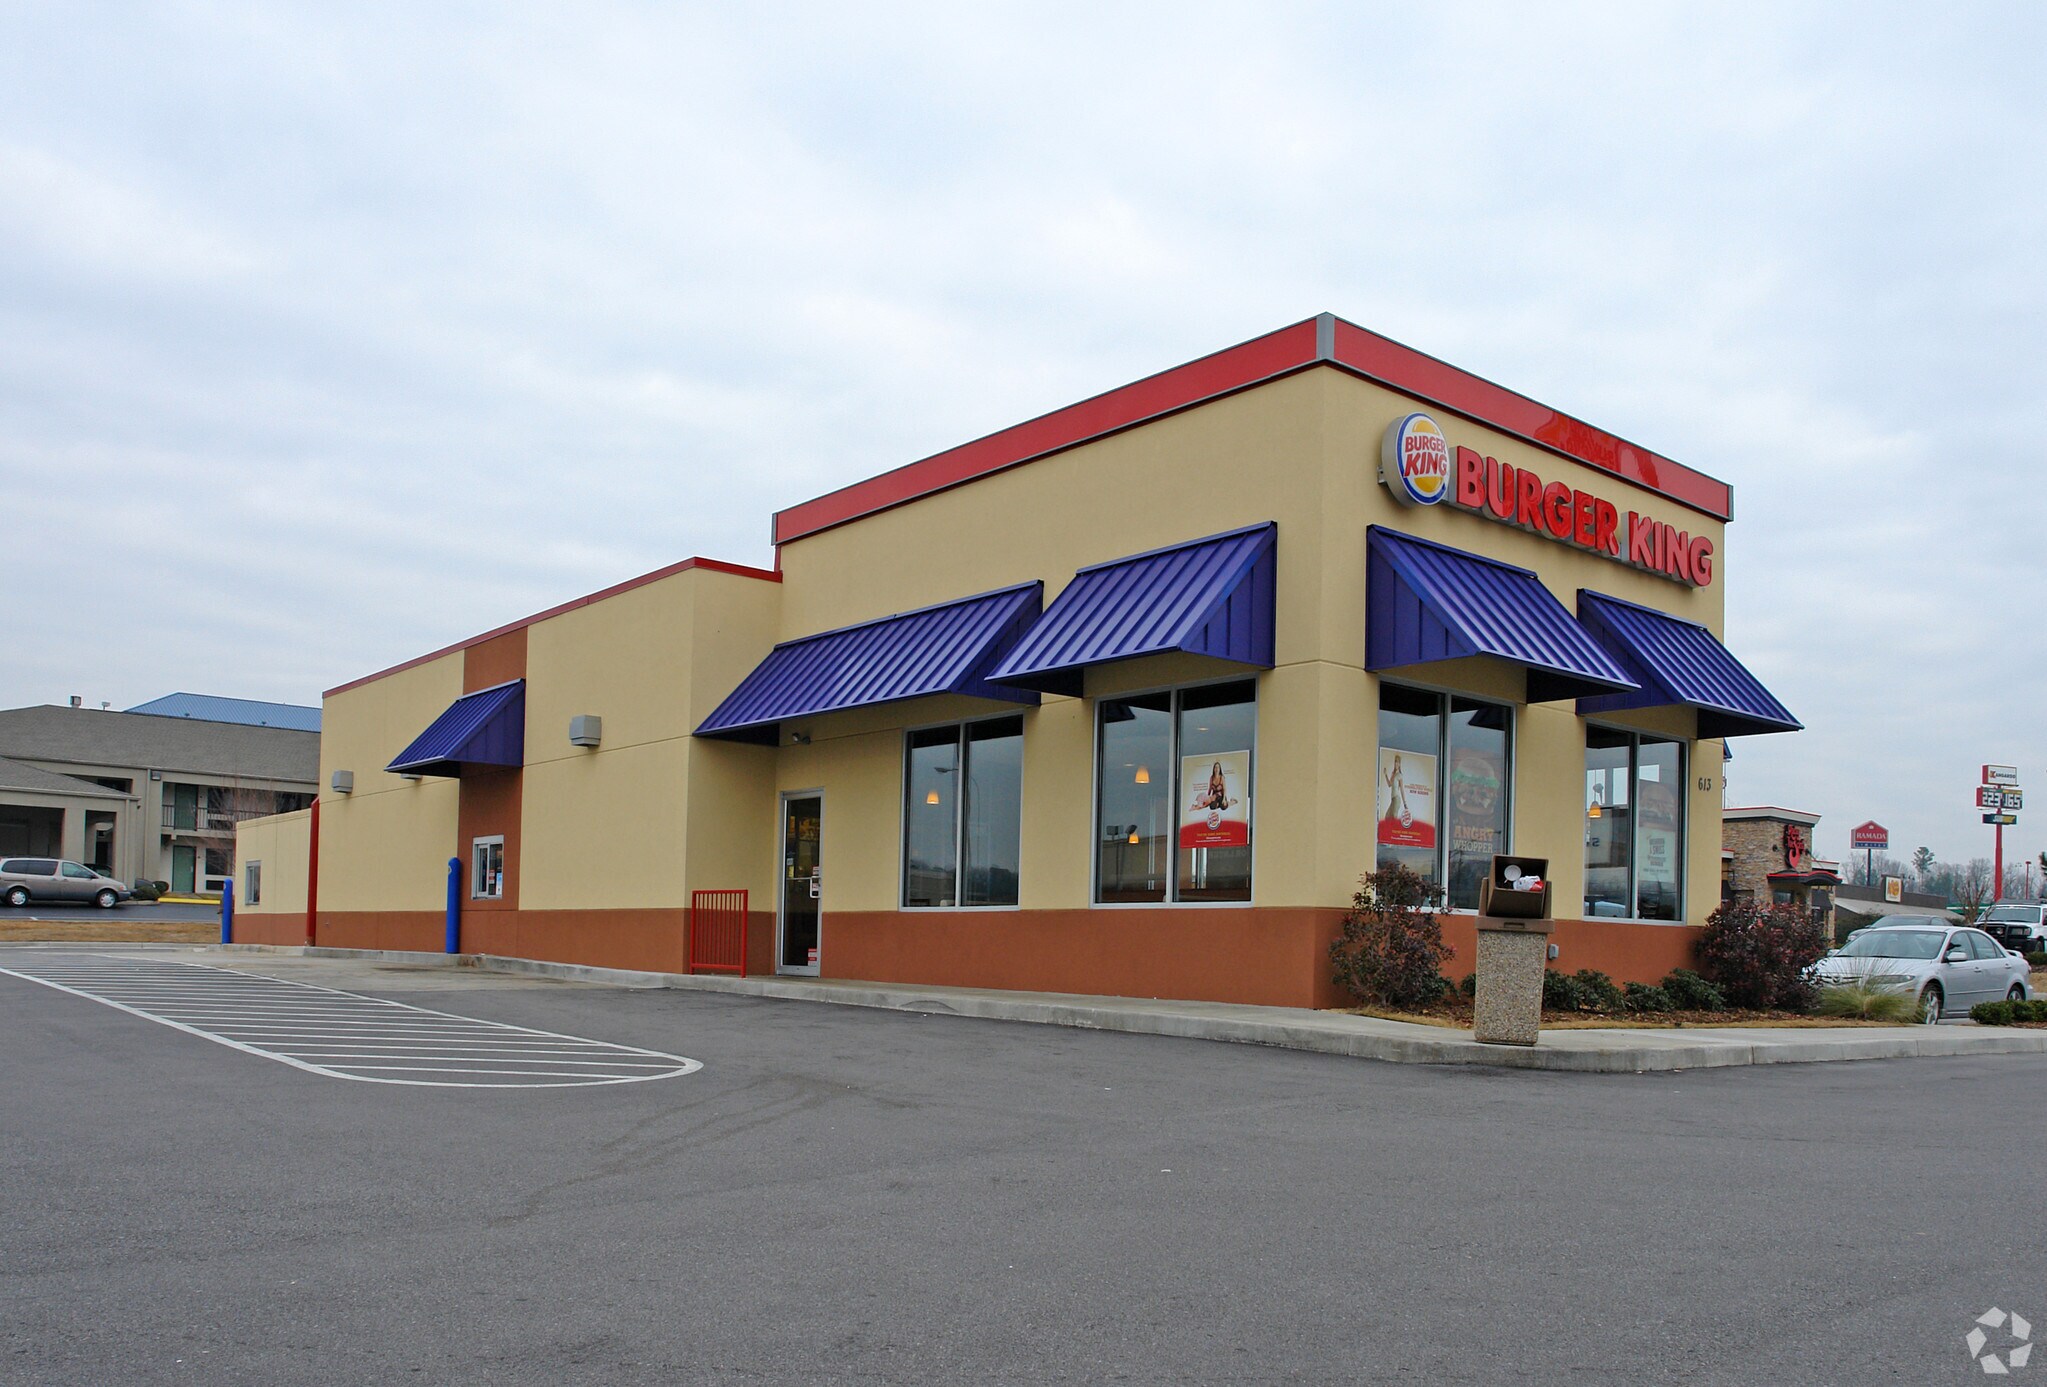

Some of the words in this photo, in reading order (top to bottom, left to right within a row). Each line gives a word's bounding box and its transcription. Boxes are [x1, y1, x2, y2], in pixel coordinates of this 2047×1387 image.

[1405, 435, 1446, 454] BURGER
[1404, 451, 1447, 477] KING
[1456, 445, 1620, 558] BURGER
[1628, 511, 1714, 588] KING
[1698, 777, 1711, 791] 613
[1454, 825, 1494, 841] ANGRY
[1856, 832, 1886, 840] RAMADA
[1453, 840, 1493, 853] WHOPPER
